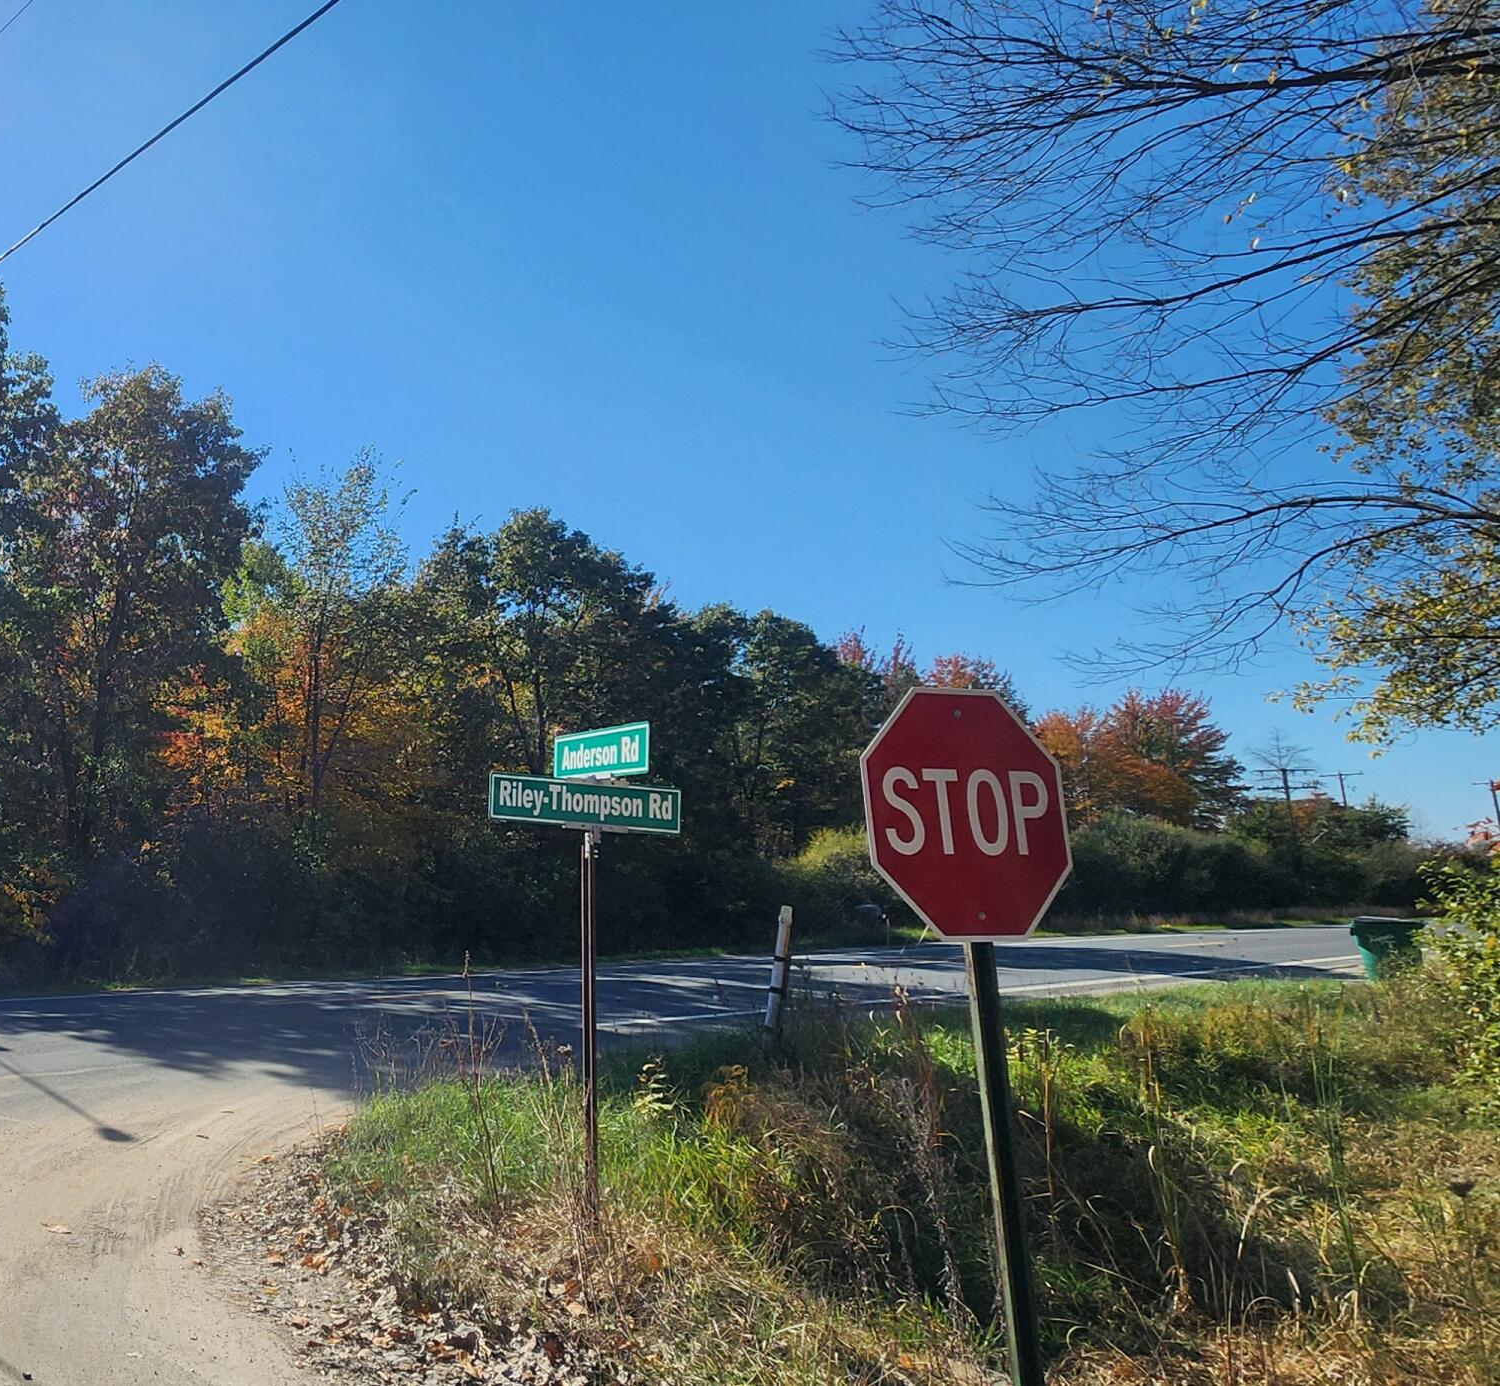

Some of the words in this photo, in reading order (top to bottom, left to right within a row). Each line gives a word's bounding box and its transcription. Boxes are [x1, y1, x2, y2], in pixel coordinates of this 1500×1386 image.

[561, 742, 618, 771] Anderson
[620, 735, 640, 763] Rd
[499, 780, 643, 821] Riley-Thompson
[649, 793, 673, 820] Rd
[882, 766, 1049, 856] STOP
